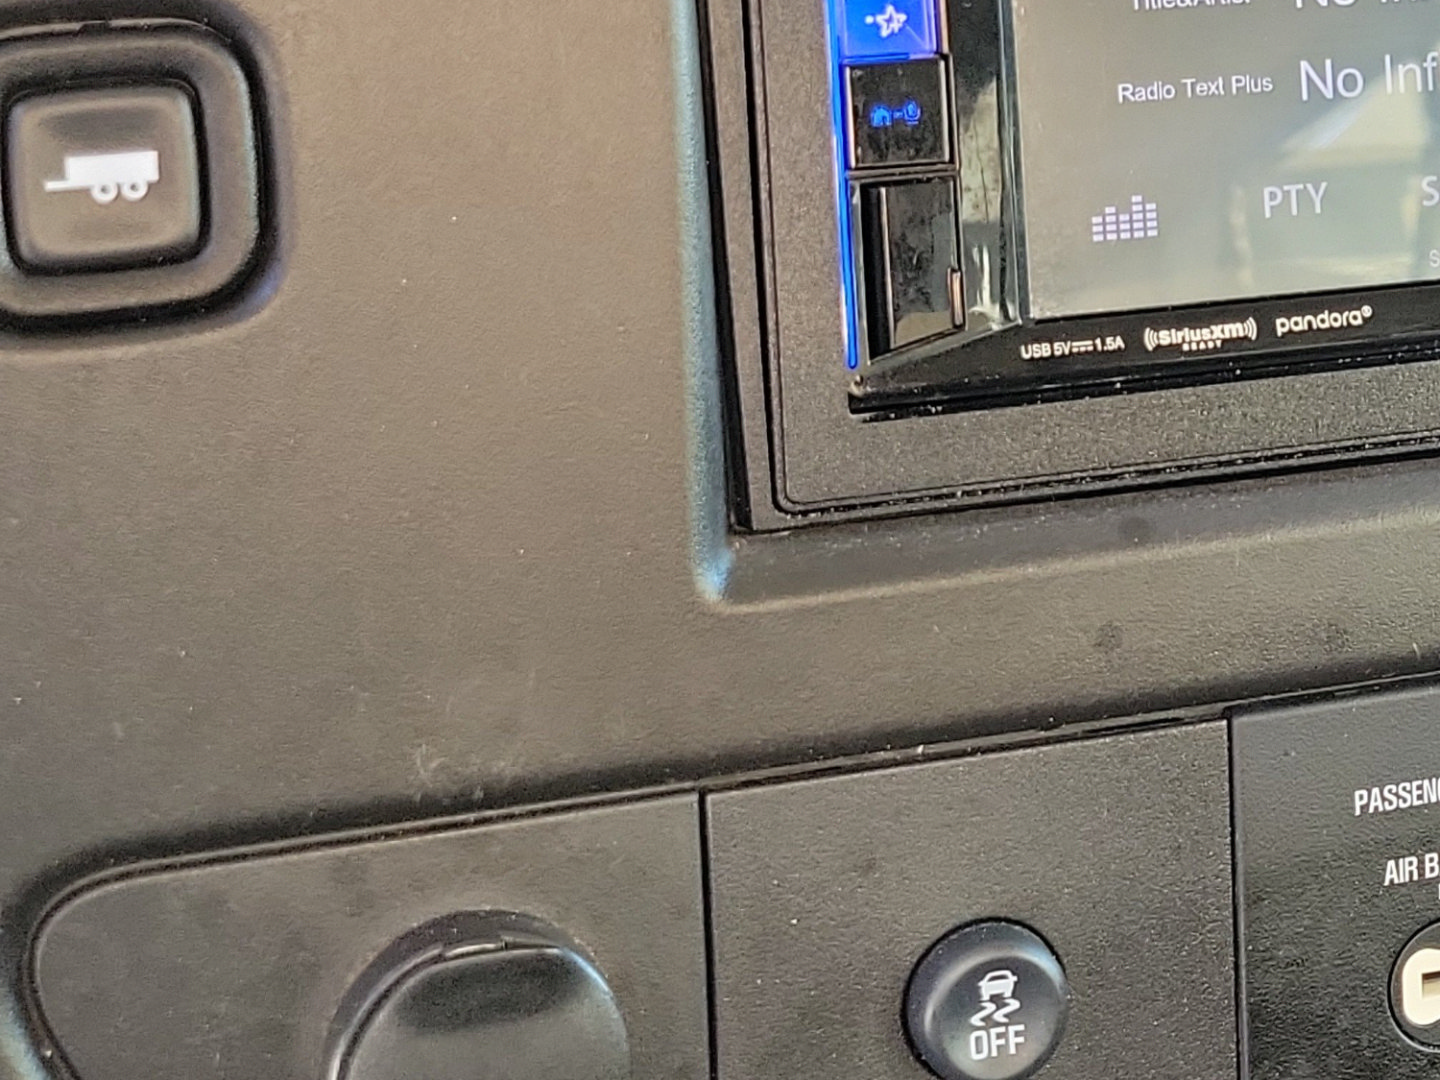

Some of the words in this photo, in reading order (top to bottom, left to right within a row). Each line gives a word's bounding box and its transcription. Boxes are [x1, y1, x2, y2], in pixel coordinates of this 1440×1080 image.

[1117, 81, 1176, 105] Radio
[1180, 76, 1225, 99] Text
[1230, 74, 1274, 96] Plus
[1299, 58, 1364, 101] No
[1262, 181, 1329, 218] PTY
[1020, 342, 1052, 360] USB
[1383, 855, 1419, 887] AIR
[969, 1023, 1026, 1061] OFF
